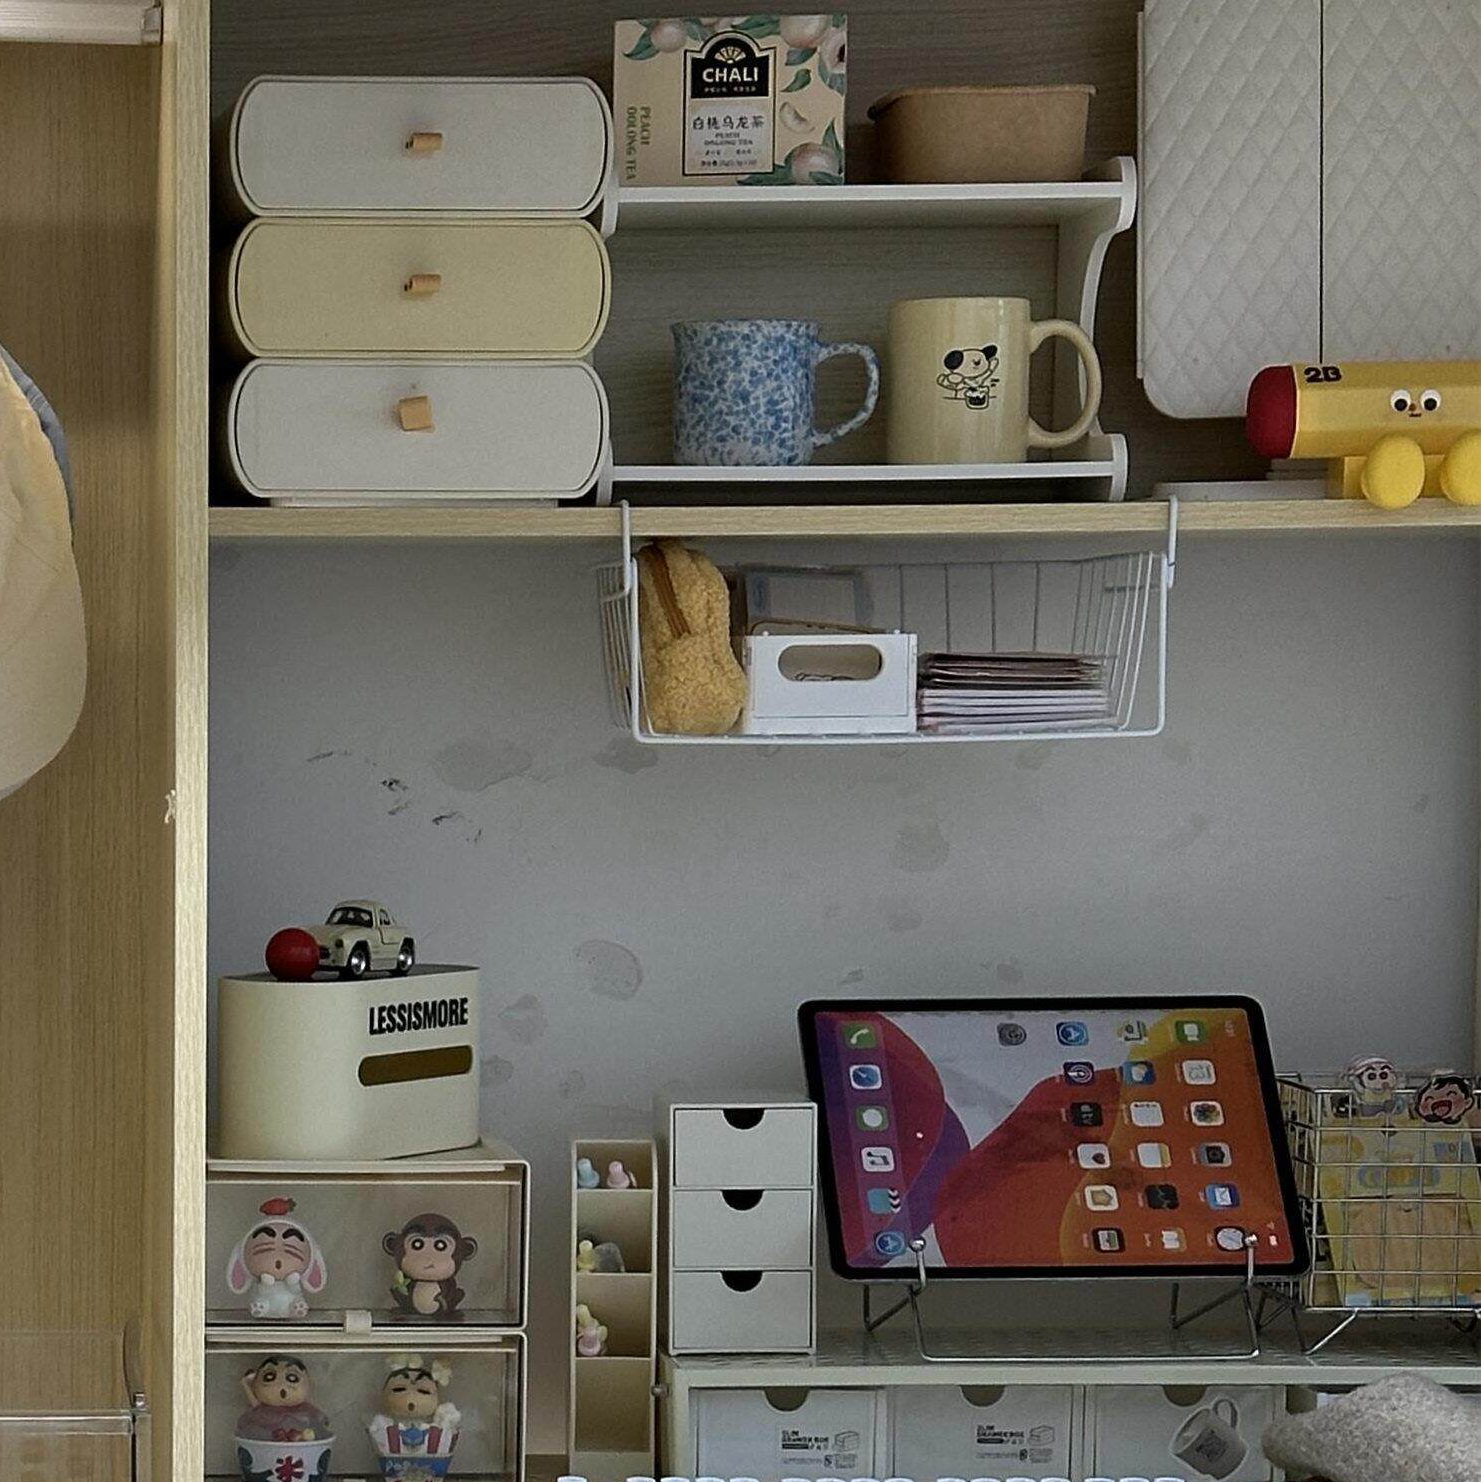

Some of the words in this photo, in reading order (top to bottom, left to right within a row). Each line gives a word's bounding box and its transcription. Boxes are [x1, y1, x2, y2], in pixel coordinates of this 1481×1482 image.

[702, 67, 759, 82] CHALI
[626, 106, 637, 157] OOLONG
[640, 106, 651, 146] PEACH
[692, 115, 765, 130] 白桃乌龙茶
[626, 159, 637, 181] TEA
[1303, 366, 1342, 384] 2B
[368, 997, 469, 1035] LESSISMORE
